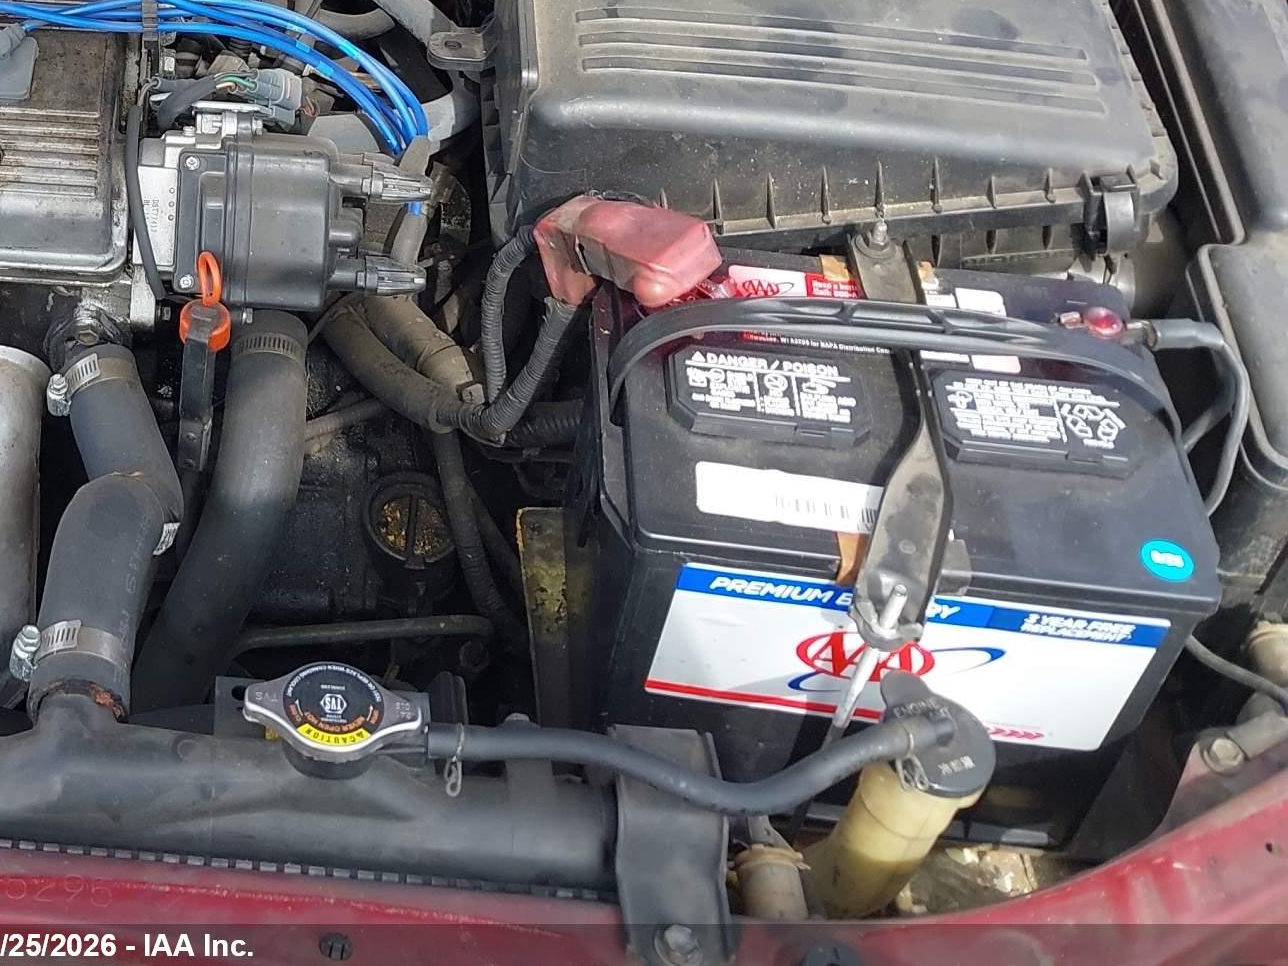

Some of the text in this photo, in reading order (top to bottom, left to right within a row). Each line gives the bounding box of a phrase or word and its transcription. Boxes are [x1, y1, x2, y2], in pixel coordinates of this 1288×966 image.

[706, 352, 768, 371] DANGER
[783, 360, 839, 378] POISON
[709, 576, 833, 604] PREMIUM
[324, 696, 342, 711] TVS
[305, 728, 357, 744] CAUTION
